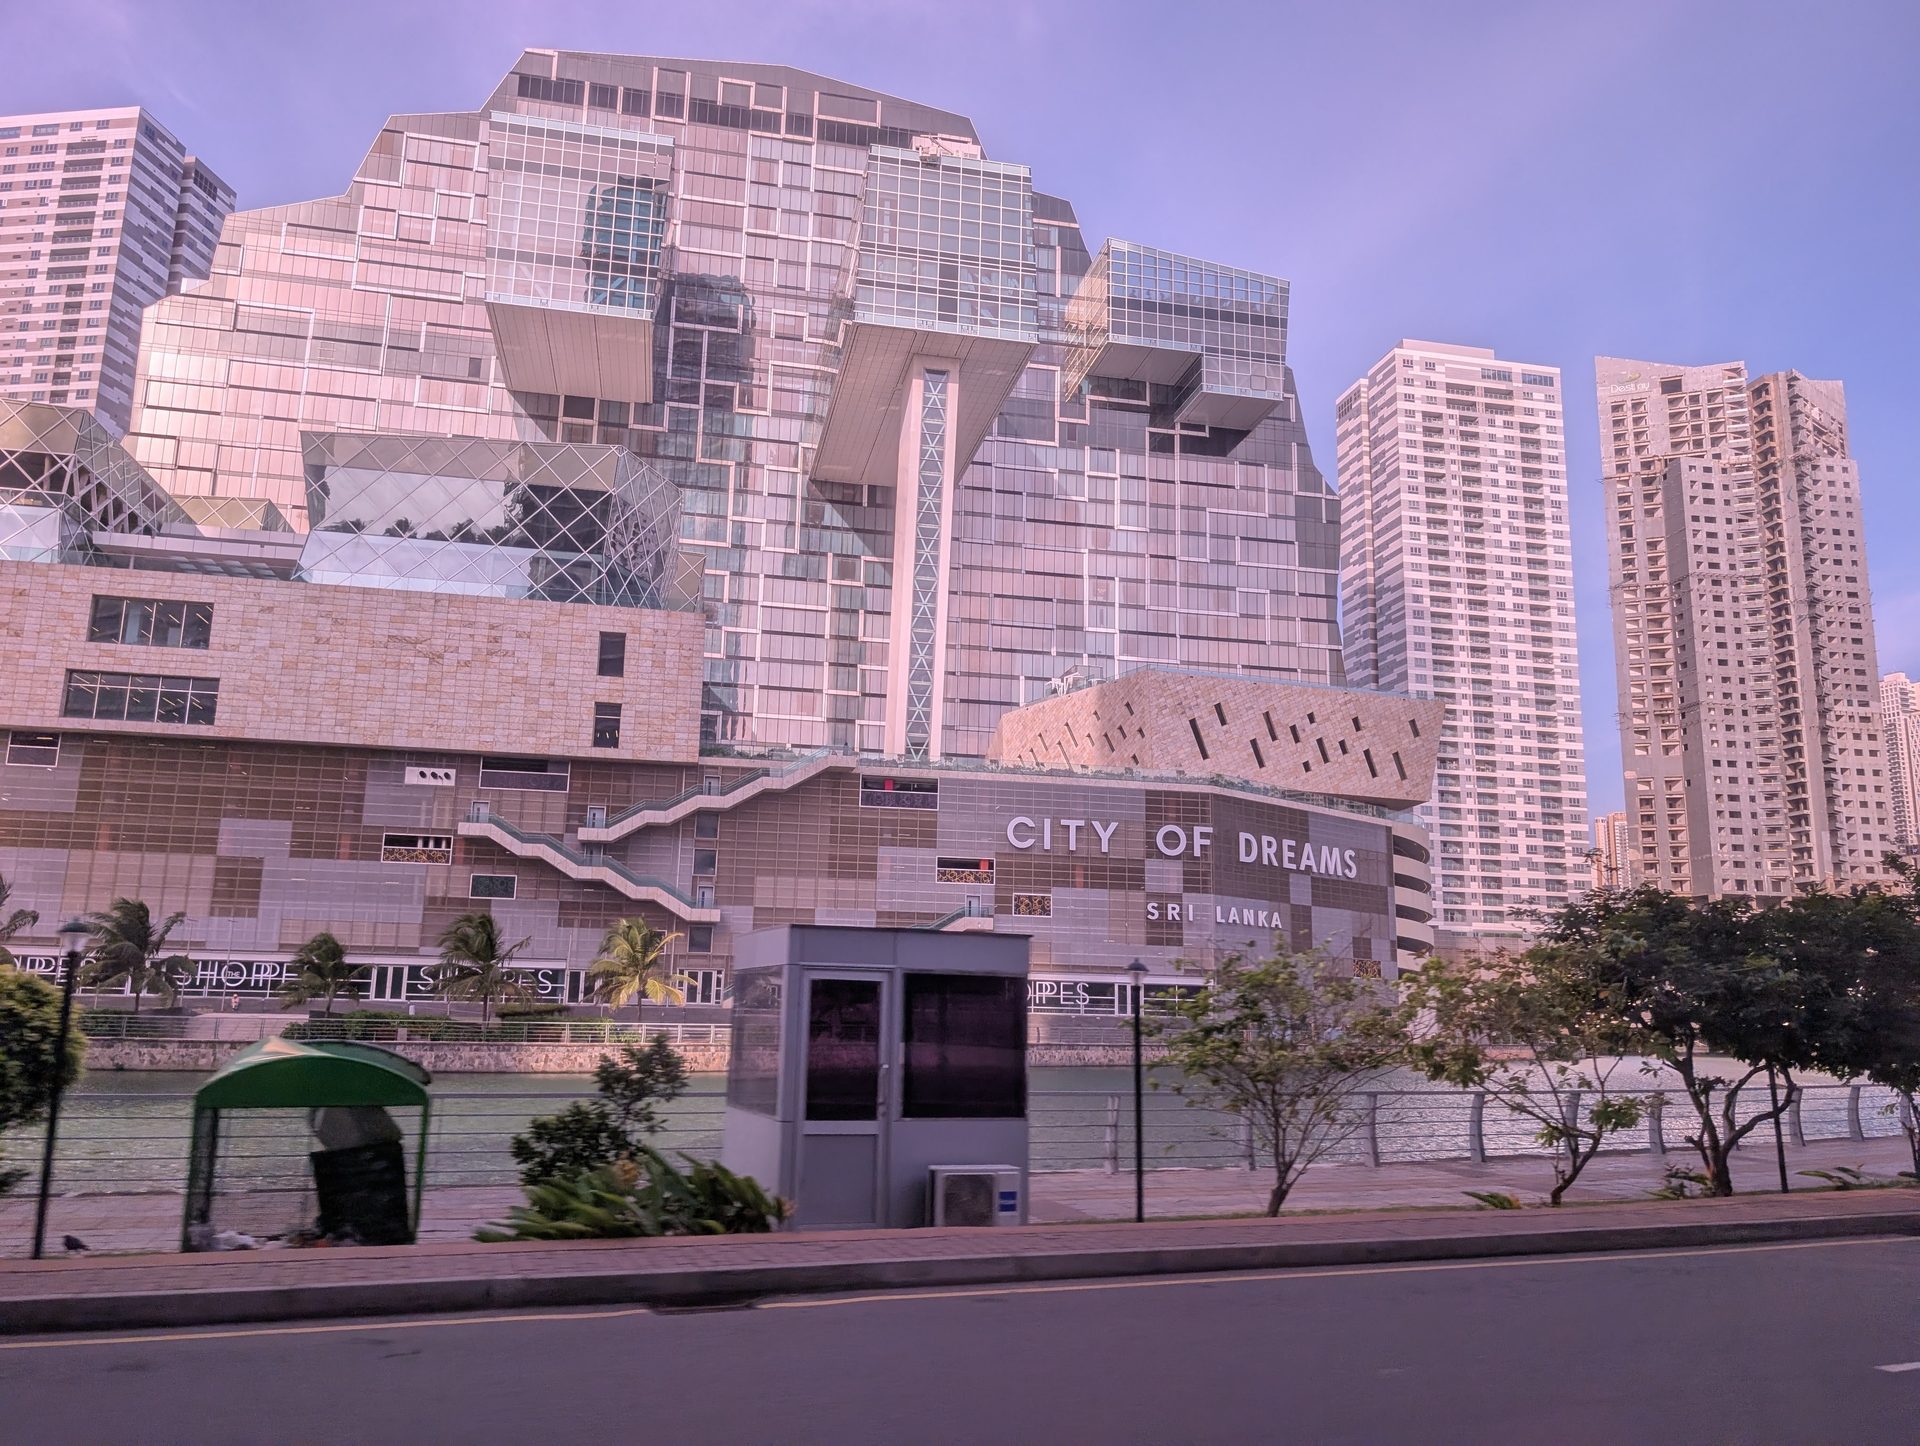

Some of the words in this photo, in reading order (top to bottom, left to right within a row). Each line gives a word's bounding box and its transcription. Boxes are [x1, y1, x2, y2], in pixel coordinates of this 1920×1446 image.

[1006, 816, 1119, 853] CITY
[1155, 824, 1214, 857] OF
[1238, 831, 1357, 879] DREAMS
[1146, 902, 1194, 921] SRI
[1215, 905, 1283, 928] LANKA
[226, 970, 240, 978] THE
